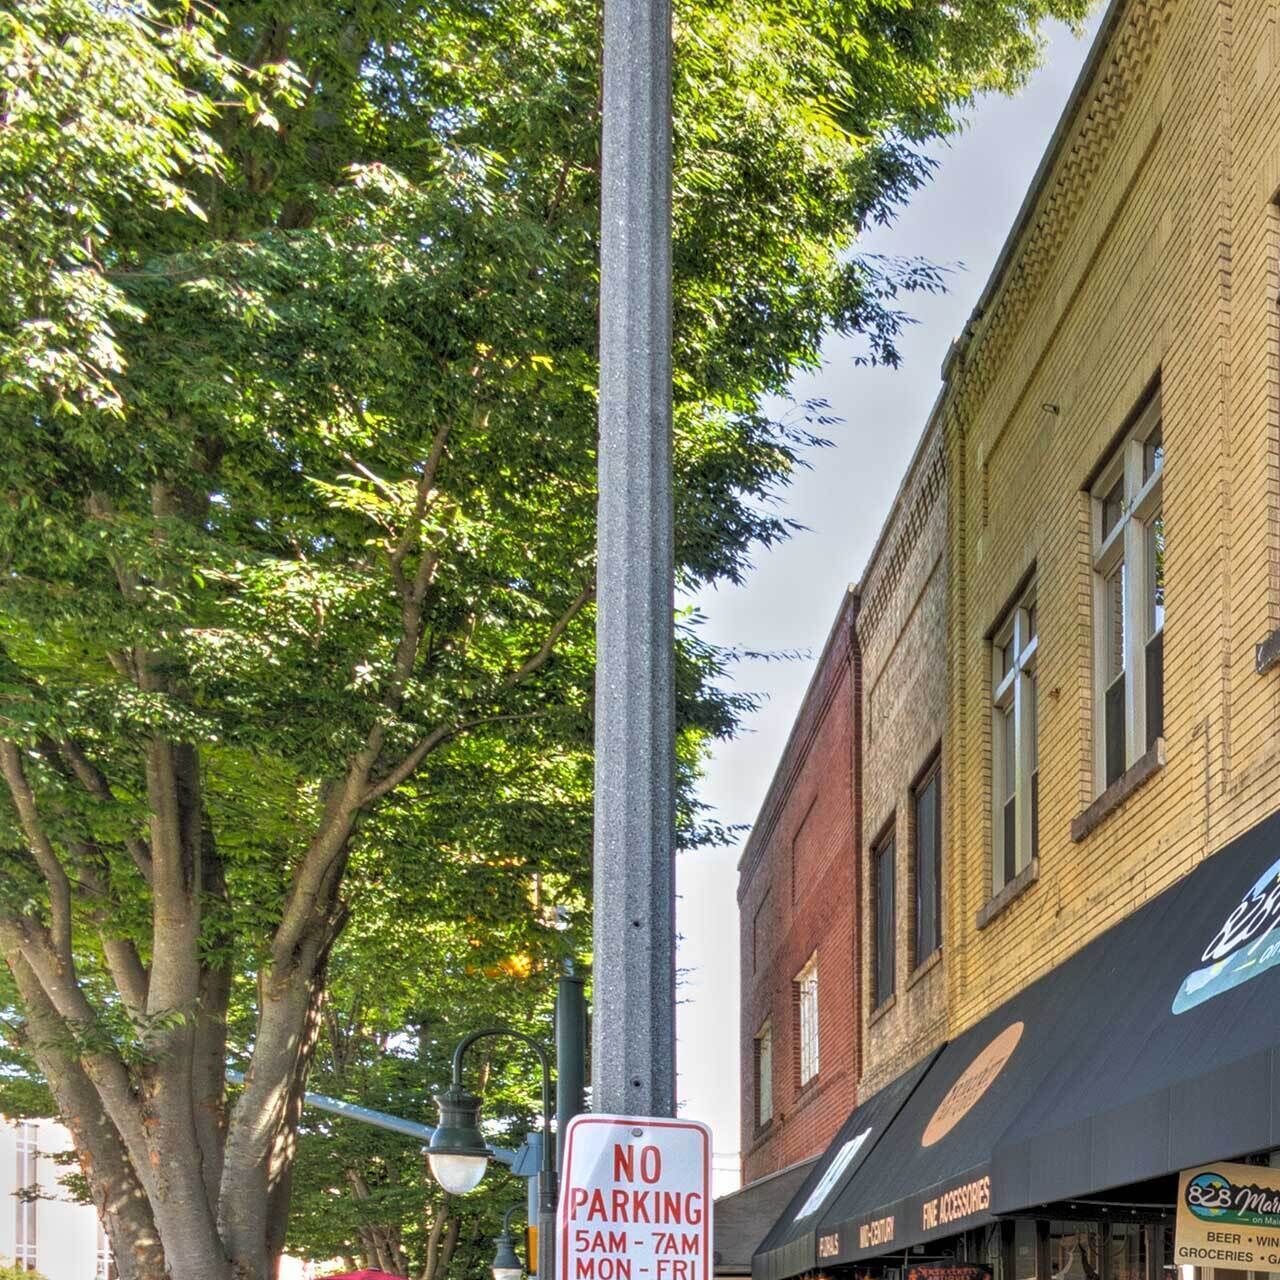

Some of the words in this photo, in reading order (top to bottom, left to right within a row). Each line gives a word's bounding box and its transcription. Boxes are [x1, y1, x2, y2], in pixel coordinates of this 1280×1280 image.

[613, 1143, 662, 1184] NO
[570, 1187, 702, 1226] PARKING
[922, 1200, 938, 1231] FINE
[938, 1175, 991, 1225] ACCESSORIES
[1188, 1186, 1232, 1208] 828
[575, 1229, 627, 1254] 5AM
[651, 1232, 700, 1255] 7AM
[1207, 1231, 1241, 1245] BEER
[1178, 1246, 1254, 1263] GROCERIES
[575, 1257, 632, 1280] MON
